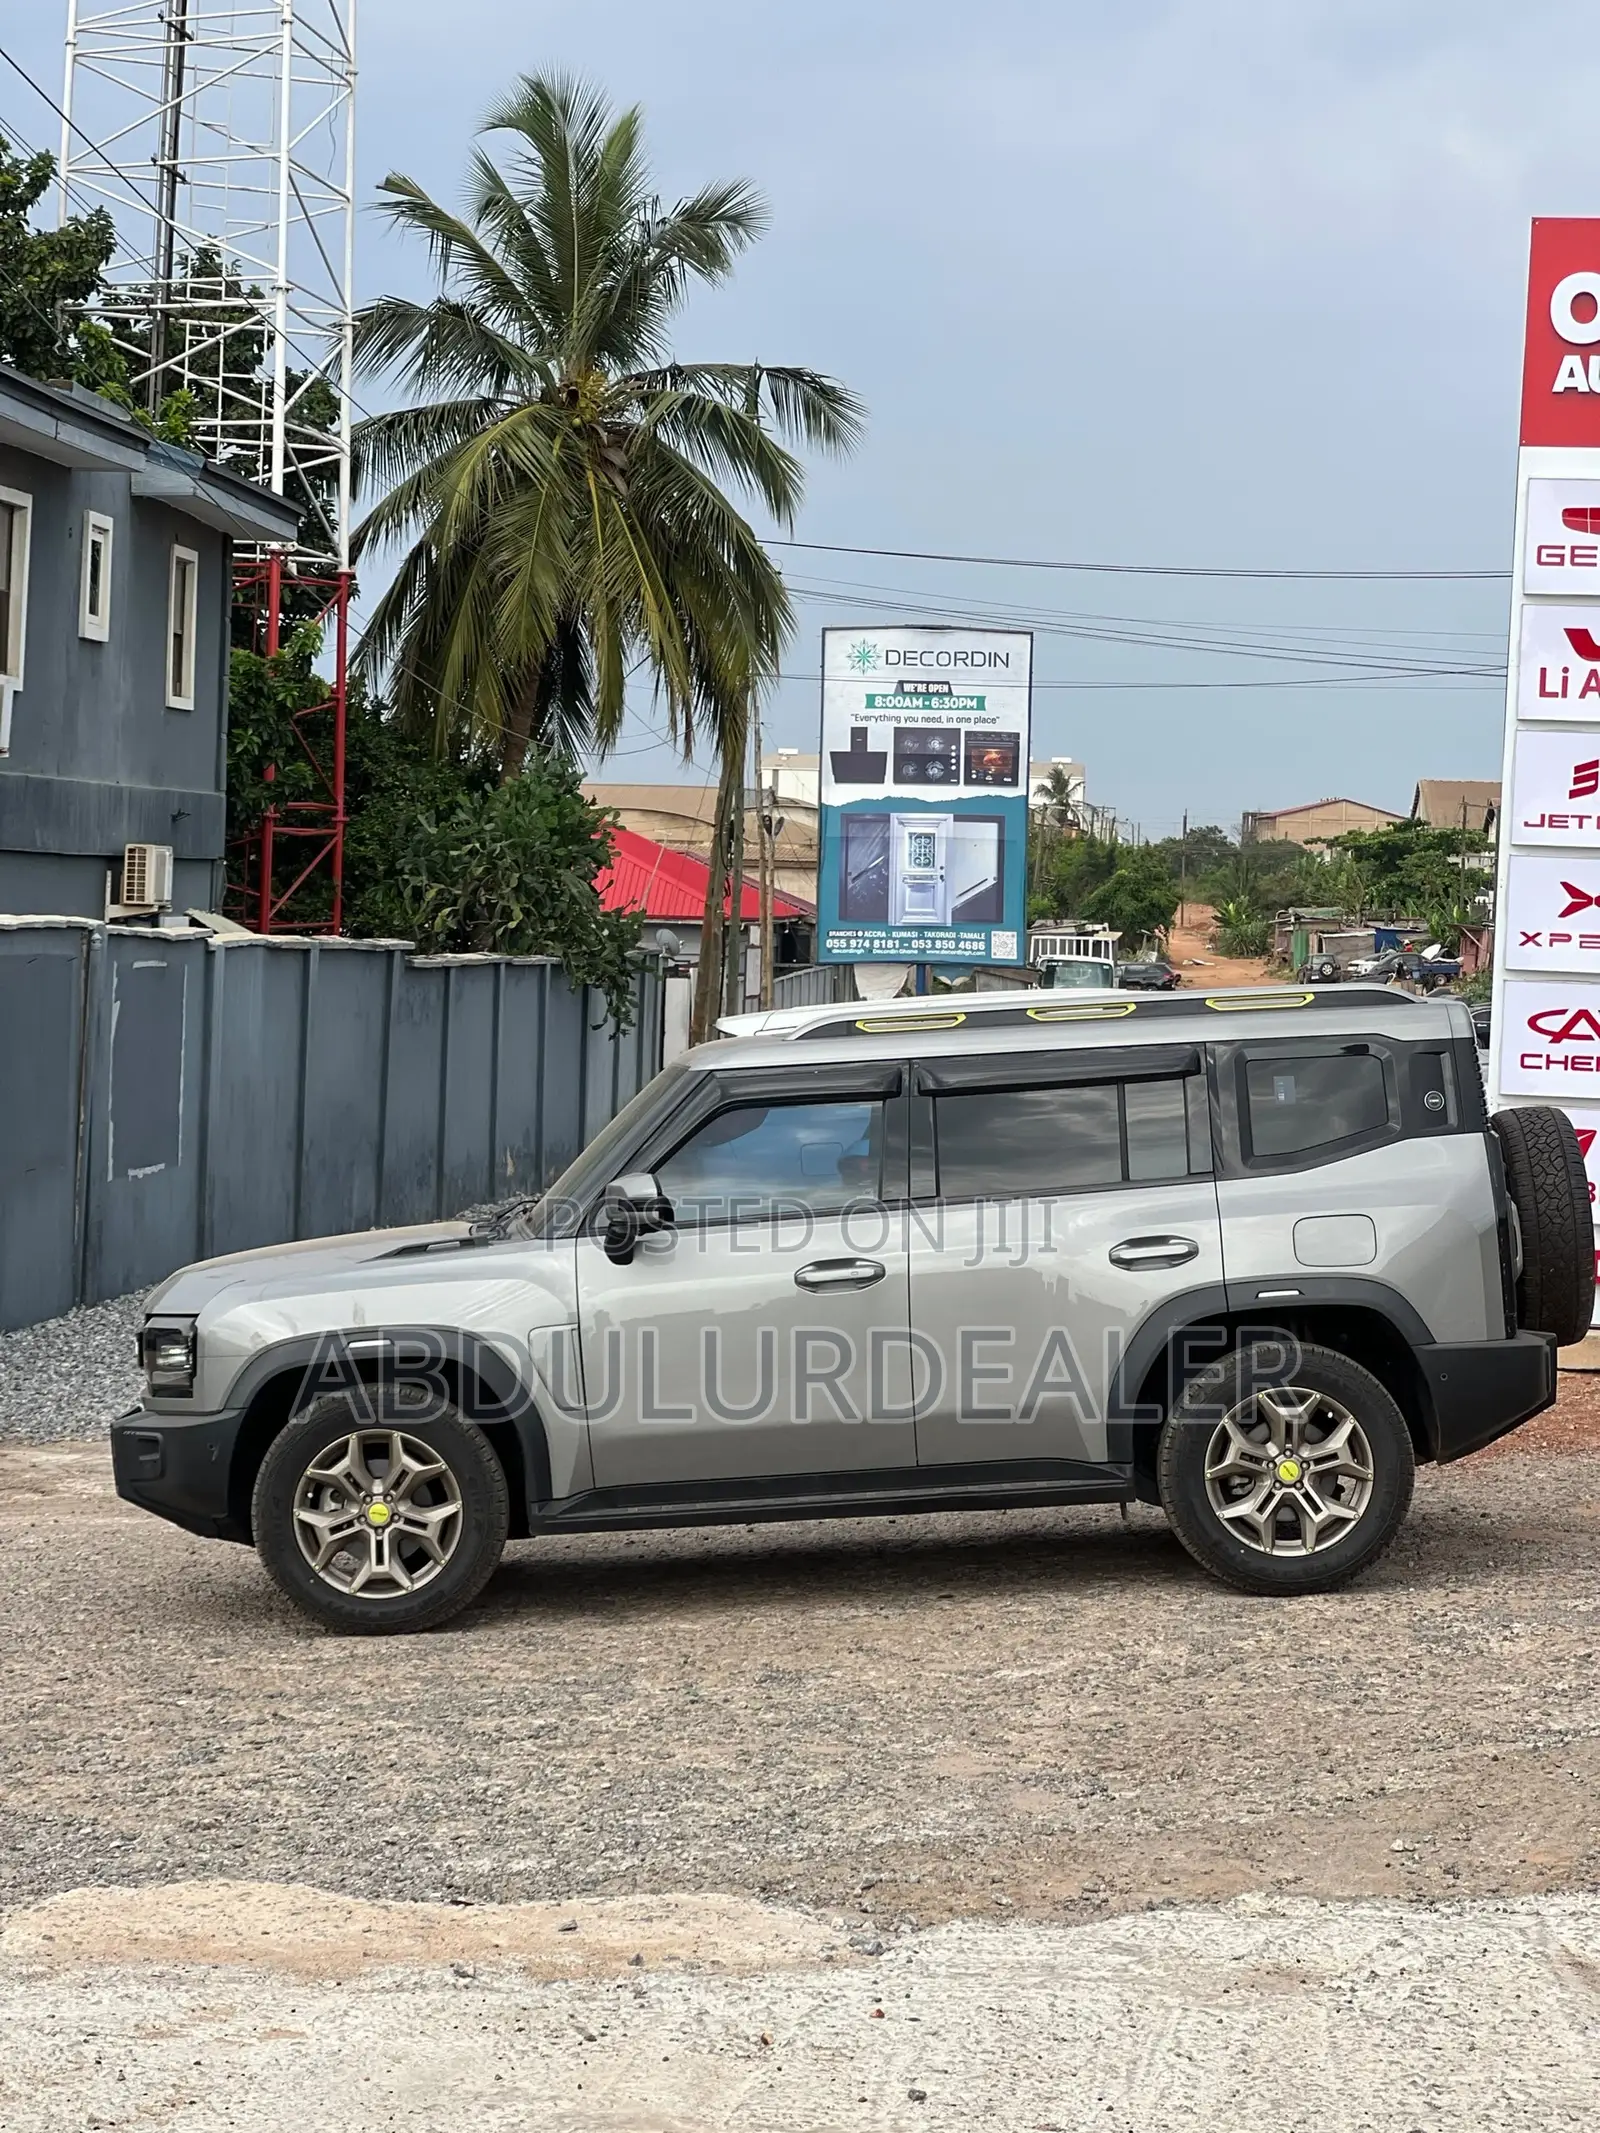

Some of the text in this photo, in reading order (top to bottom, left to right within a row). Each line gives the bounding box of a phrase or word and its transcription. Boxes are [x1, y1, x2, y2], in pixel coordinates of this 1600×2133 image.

[885, 649, 1009, 668] DECORDIN
[903, 683, 950, 693] WE'RE OPEN
[1539, 666, 1570, 699] Li
[904, 716, 919, 725] you
[921, 715, 945, 724] need,
[946, 715, 954, 724] in
[955, 716, 972, 724] one
[1524, 813, 1600, 830] JET
[864, 930, 886, 938] ACCRA
[891, 930, 919, 938] KUMASI
[924, 931, 956, 939] TAKORADI
[826, 939, 847, 949] 055
[849, 939, 870, 949] 974
[873, 939, 900, 949] 8181
[911, 939, 932, 949] 053
[935, 940, 956, 950] 850
[958, 940, 986, 951] 4686
[1520, 1053, 1600, 1073] CHE
